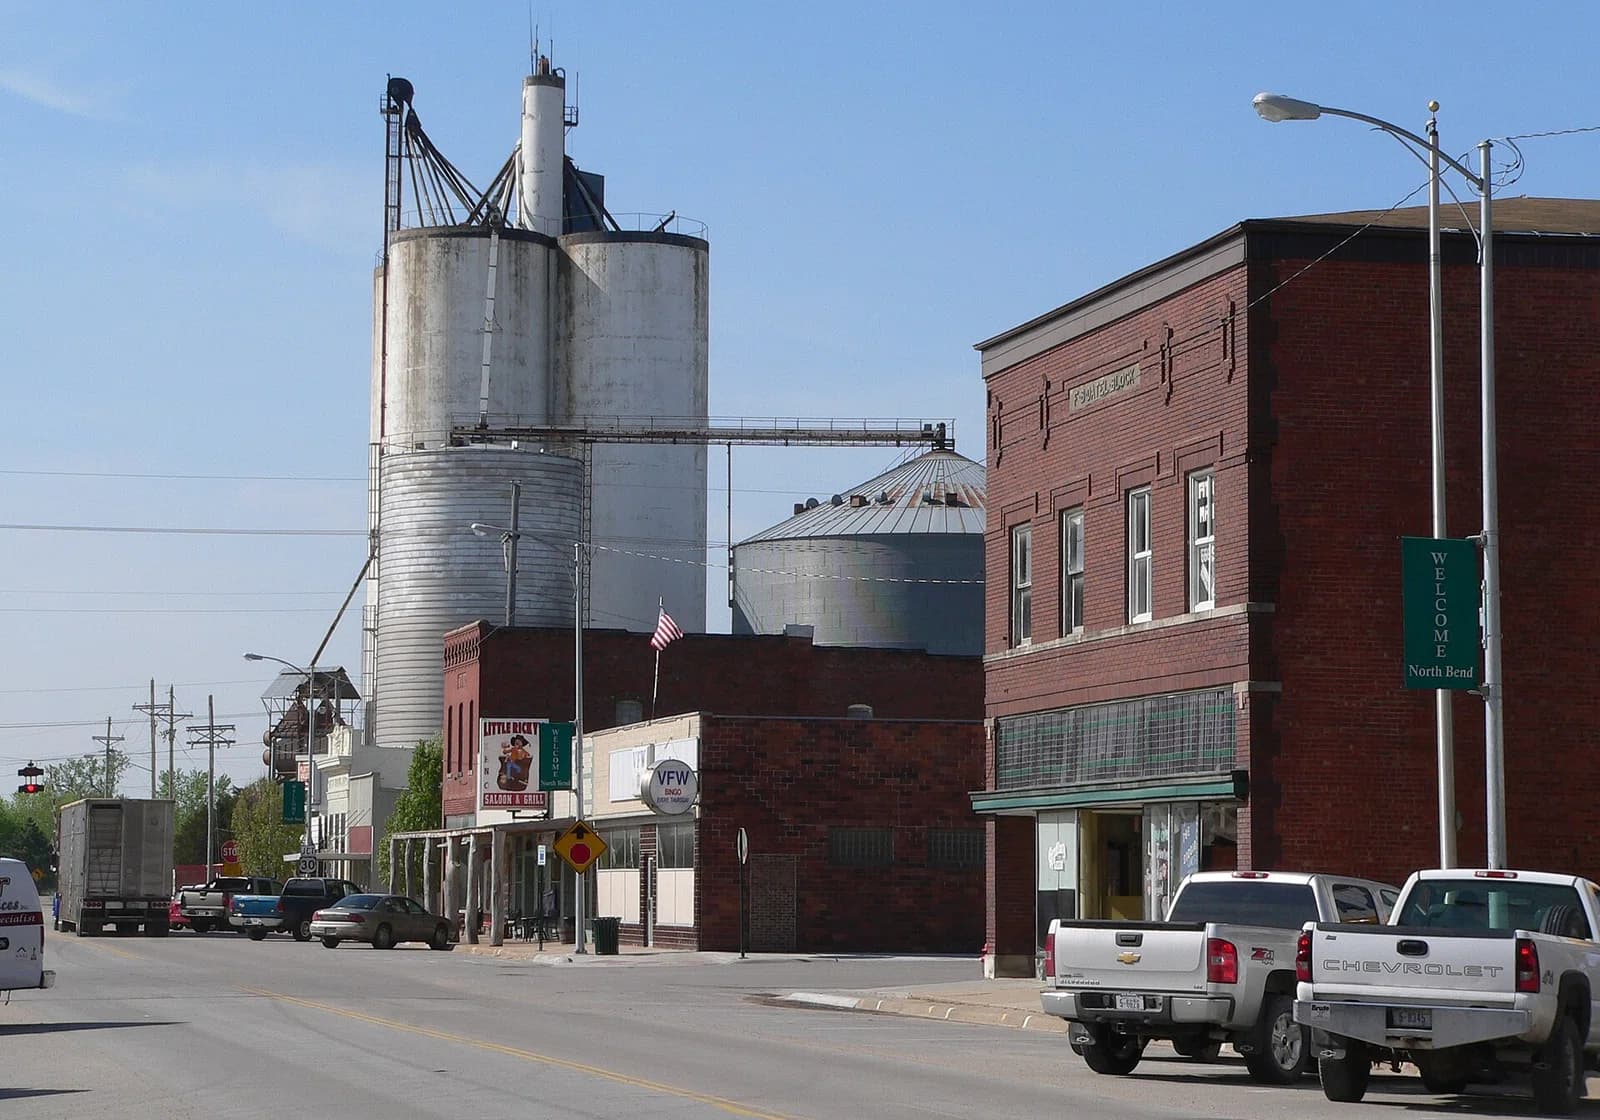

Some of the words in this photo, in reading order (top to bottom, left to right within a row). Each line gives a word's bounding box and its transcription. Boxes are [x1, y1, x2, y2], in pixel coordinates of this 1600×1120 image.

[1431, 552, 1449, 658] WELCOME
[1409, 664, 1442, 678] North
[1446, 665, 1474, 678] Bend
[483, 721, 511, 737] LITTLE
[551, 728, 560, 778] WELCOME
[657, 770, 690, 786] VFW
[484, 794, 513, 805] SALOON
[523, 793, 544, 805] GRILL
[223, 847, 239, 857] STO
[301, 847, 315, 855] JCT
[301, 860, 315, 870] 30
[0, 901, 19, 911] ces
[1322, 959, 1504, 978] CHEVROLET
